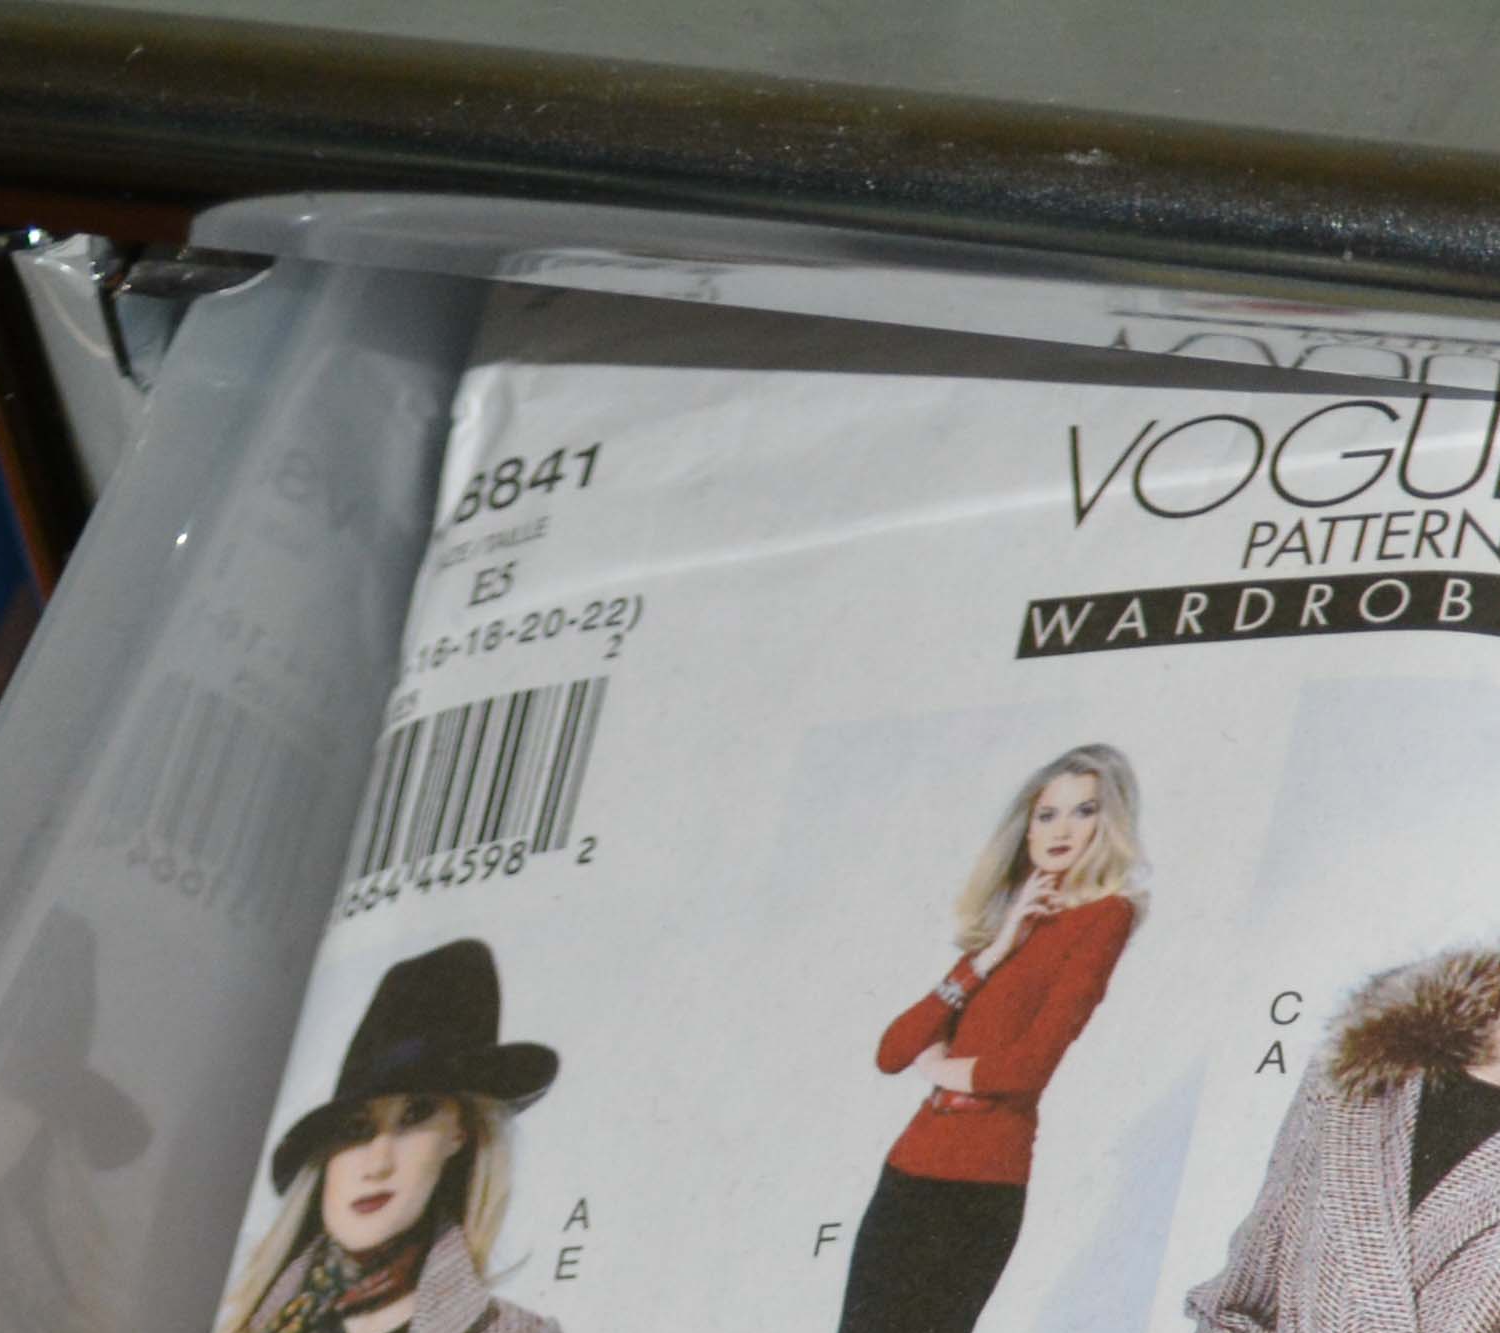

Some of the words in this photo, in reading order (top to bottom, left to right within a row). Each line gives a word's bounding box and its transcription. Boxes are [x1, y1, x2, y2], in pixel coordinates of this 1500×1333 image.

[575, 836, 598, 867] 2
[1269, 990, 1303, 1026] C
[1254, 1040, 1287, 1075] A
[562, 1197, 591, 1232] A
[812, 1222, 843, 1258] F
[553, 1246, 584, 1282] E
